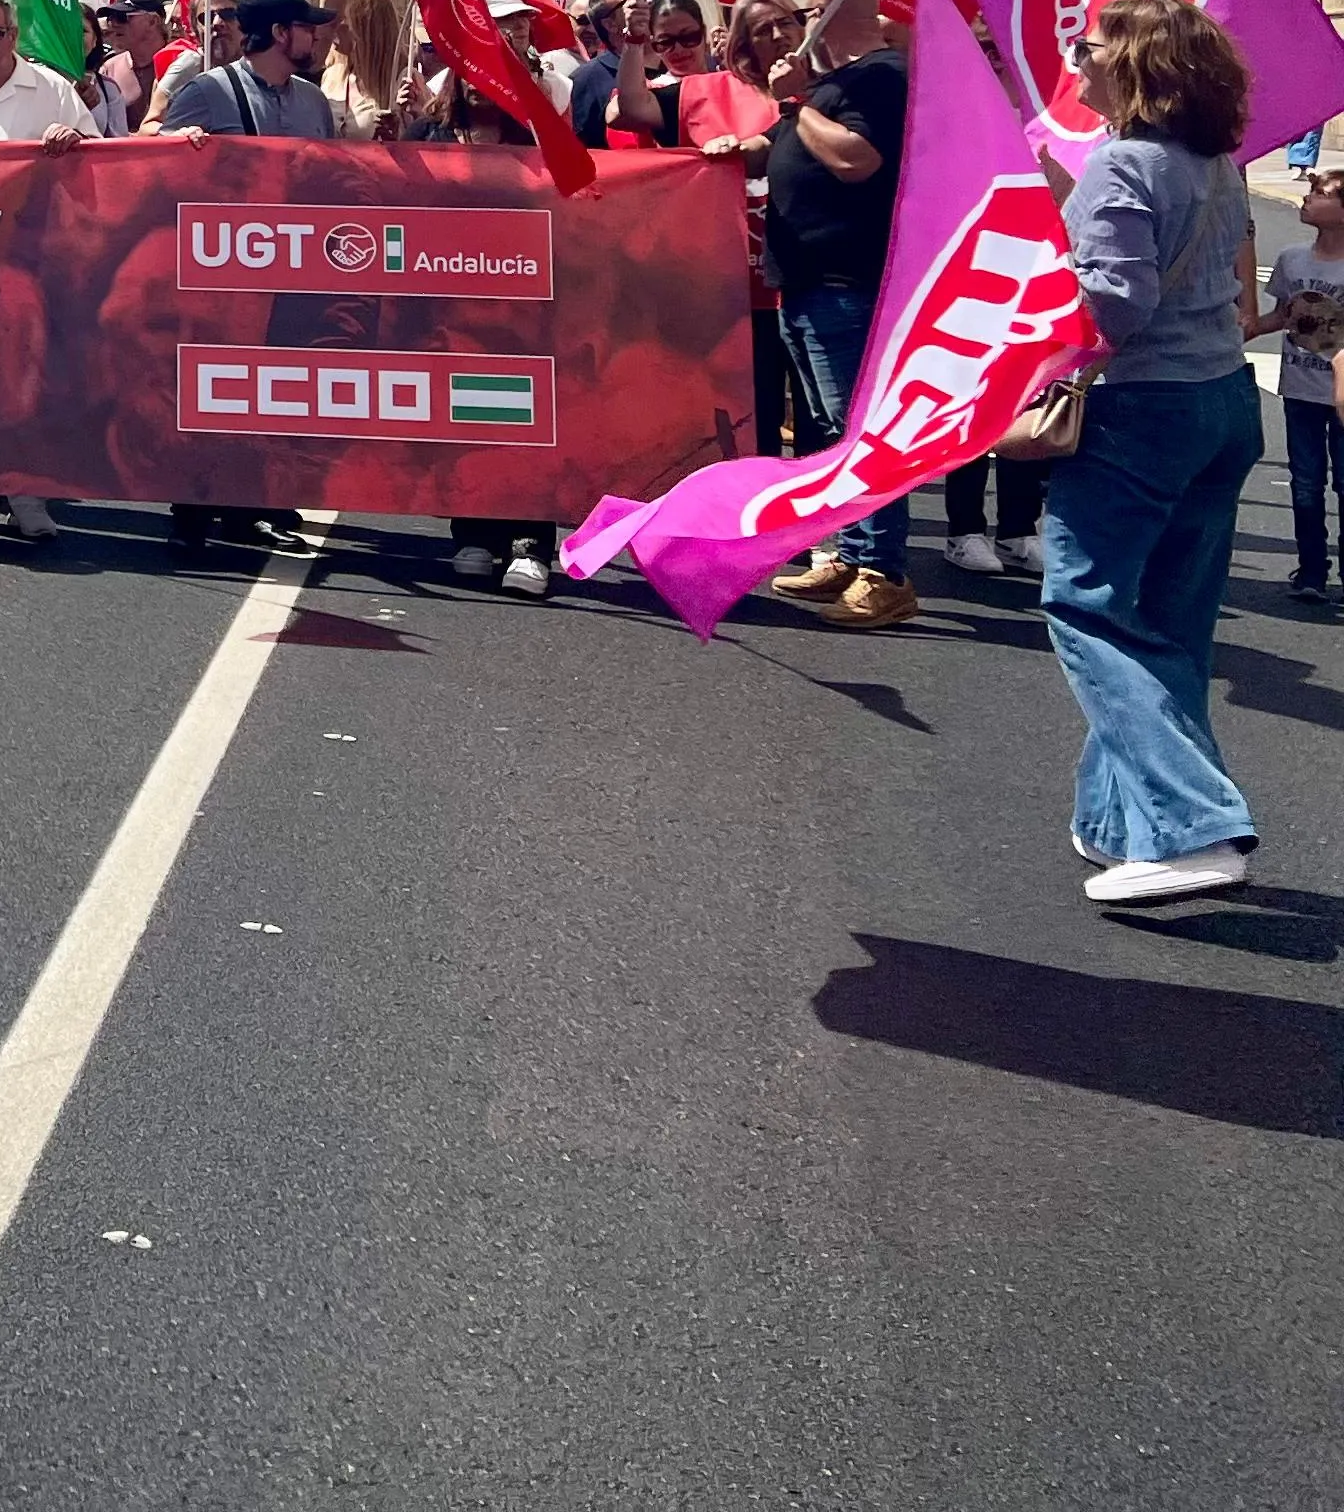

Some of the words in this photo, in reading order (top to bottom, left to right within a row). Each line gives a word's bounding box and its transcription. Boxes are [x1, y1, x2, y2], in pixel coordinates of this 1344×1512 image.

[192, 221, 315, 269] UGT
[413, 251, 538, 276] Andalucía
[197, 364, 430, 422] CCOO
